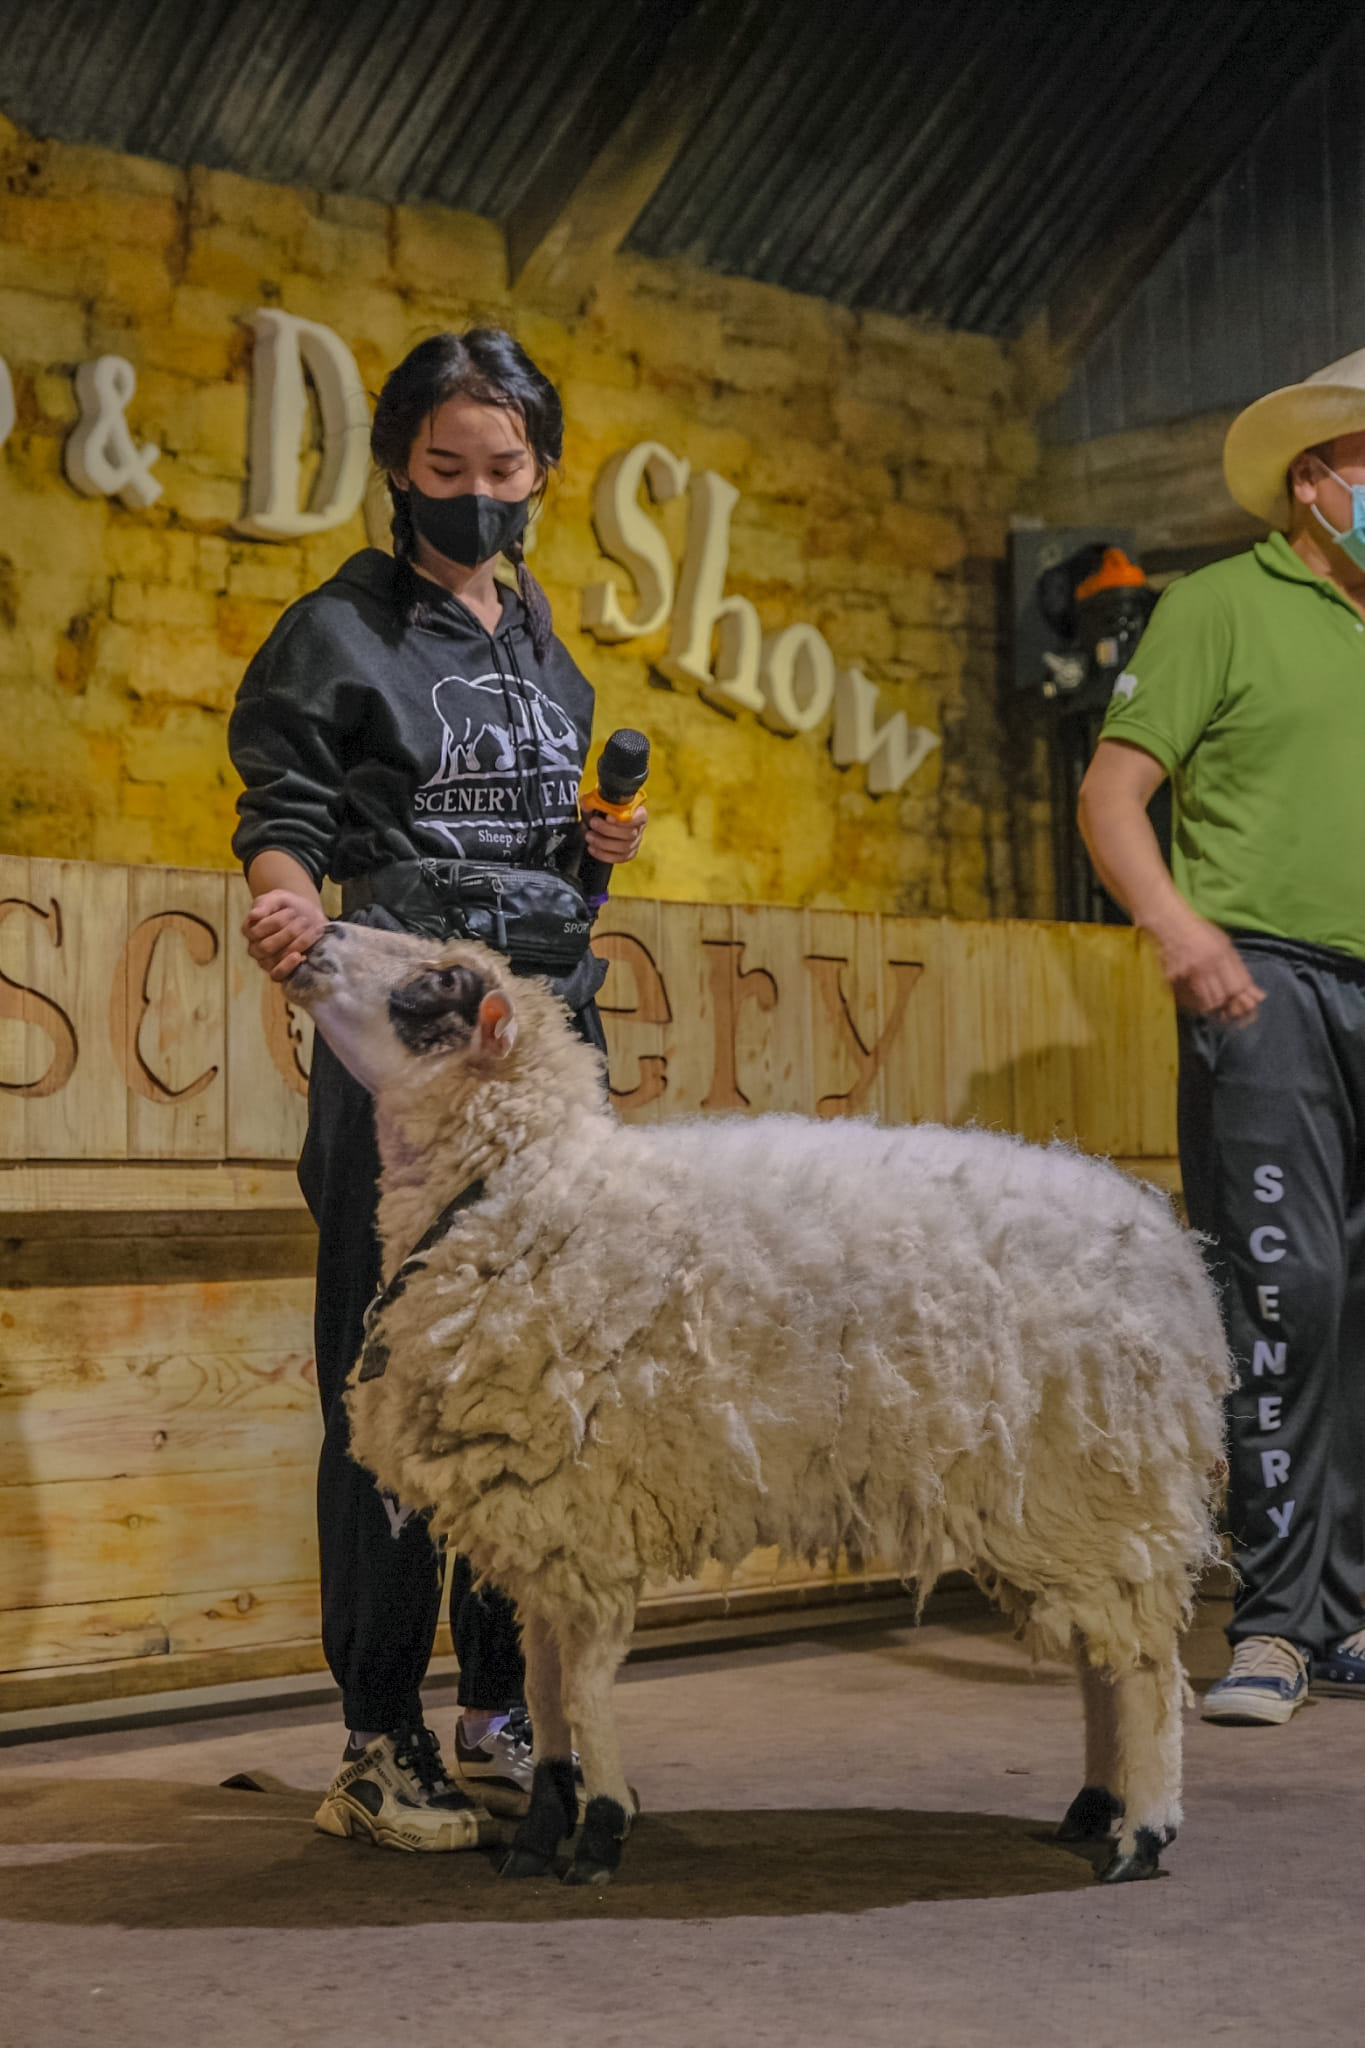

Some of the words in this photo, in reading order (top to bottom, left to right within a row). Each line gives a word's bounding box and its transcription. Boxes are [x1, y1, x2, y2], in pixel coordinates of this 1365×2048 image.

[66, 354, 163, 509] &
[580, 440, 942, 793] Show
[414, 786, 522, 812] SCENERY
[541, 780, 580, 807] FAR
[478, 829, 513, 848] Sheep
[1249, 1164, 1296, 1539] SCENERY
